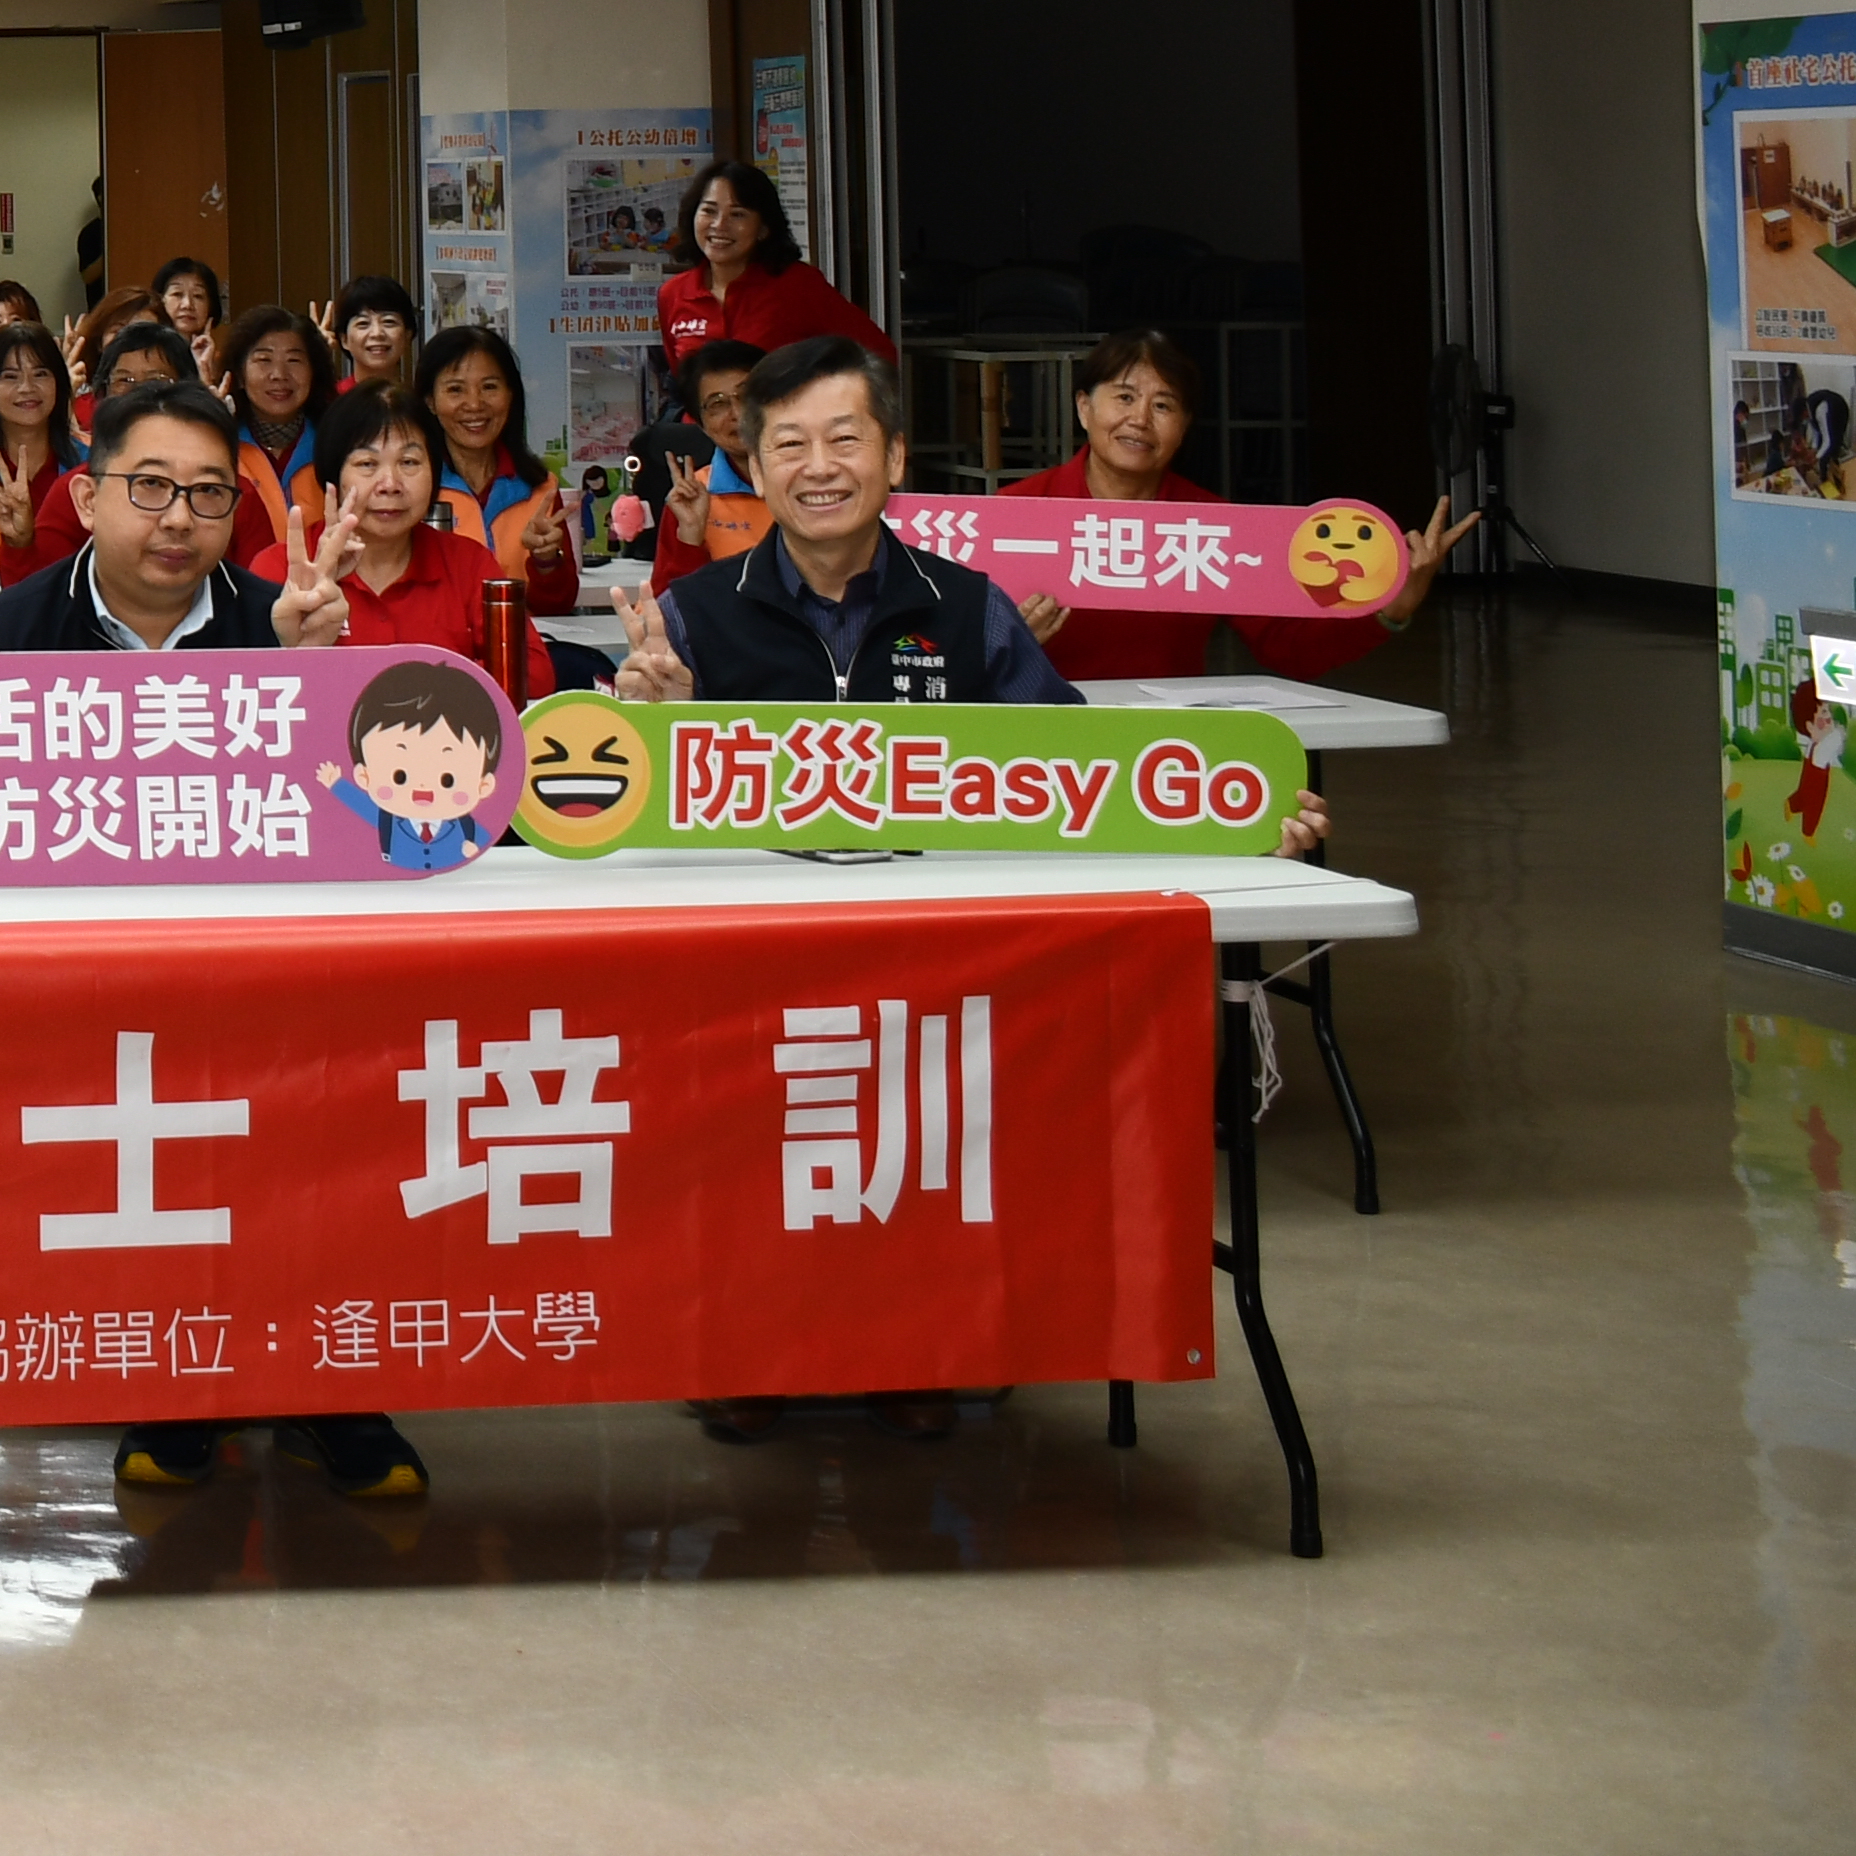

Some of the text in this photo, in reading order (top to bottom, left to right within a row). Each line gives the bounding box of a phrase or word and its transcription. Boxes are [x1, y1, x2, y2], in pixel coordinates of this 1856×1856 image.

[1747, 53, 1856, 88] 首座社宅公托
[590, 128, 697, 146] 公托公幼倍增
[879, 509, 1262, 592] 災一起來~
[891, 654, 945, 668] 臺中市政府
[924, 675, 947, 700] 消
[674, 723, 1265, 834] 防災Easy Go
